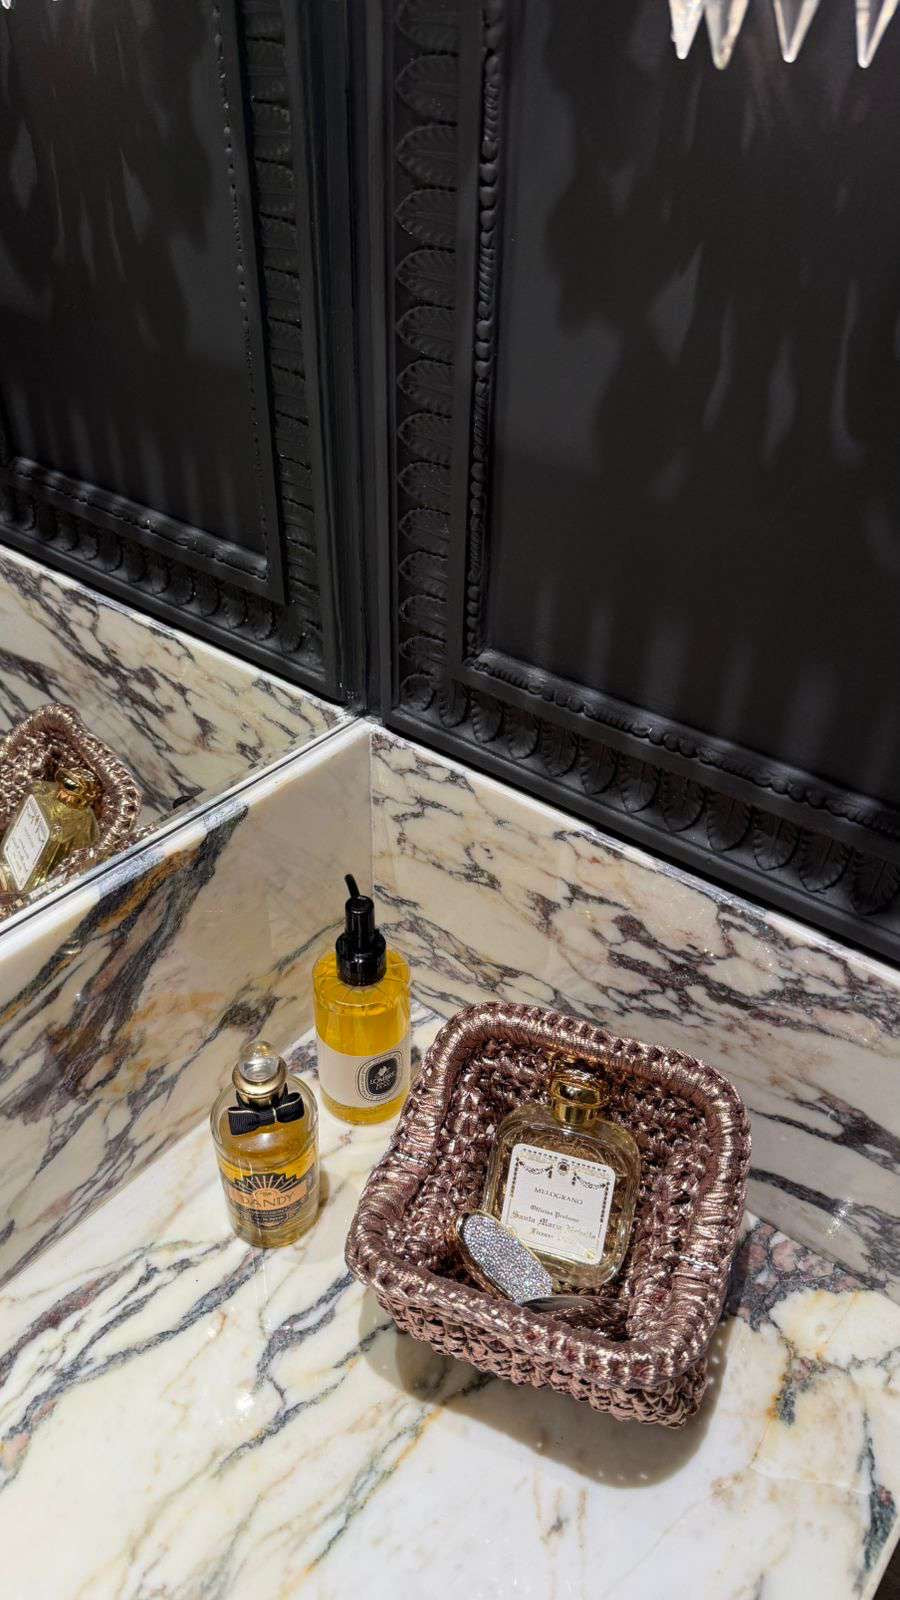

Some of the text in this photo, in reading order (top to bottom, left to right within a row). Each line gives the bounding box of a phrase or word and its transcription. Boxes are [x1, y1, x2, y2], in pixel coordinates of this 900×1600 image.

[241, 1191, 294, 1207] DANDY
[535, 1187, 583, 1205] MELOGRANO
[512, 1210, 535, 1223] Santa
